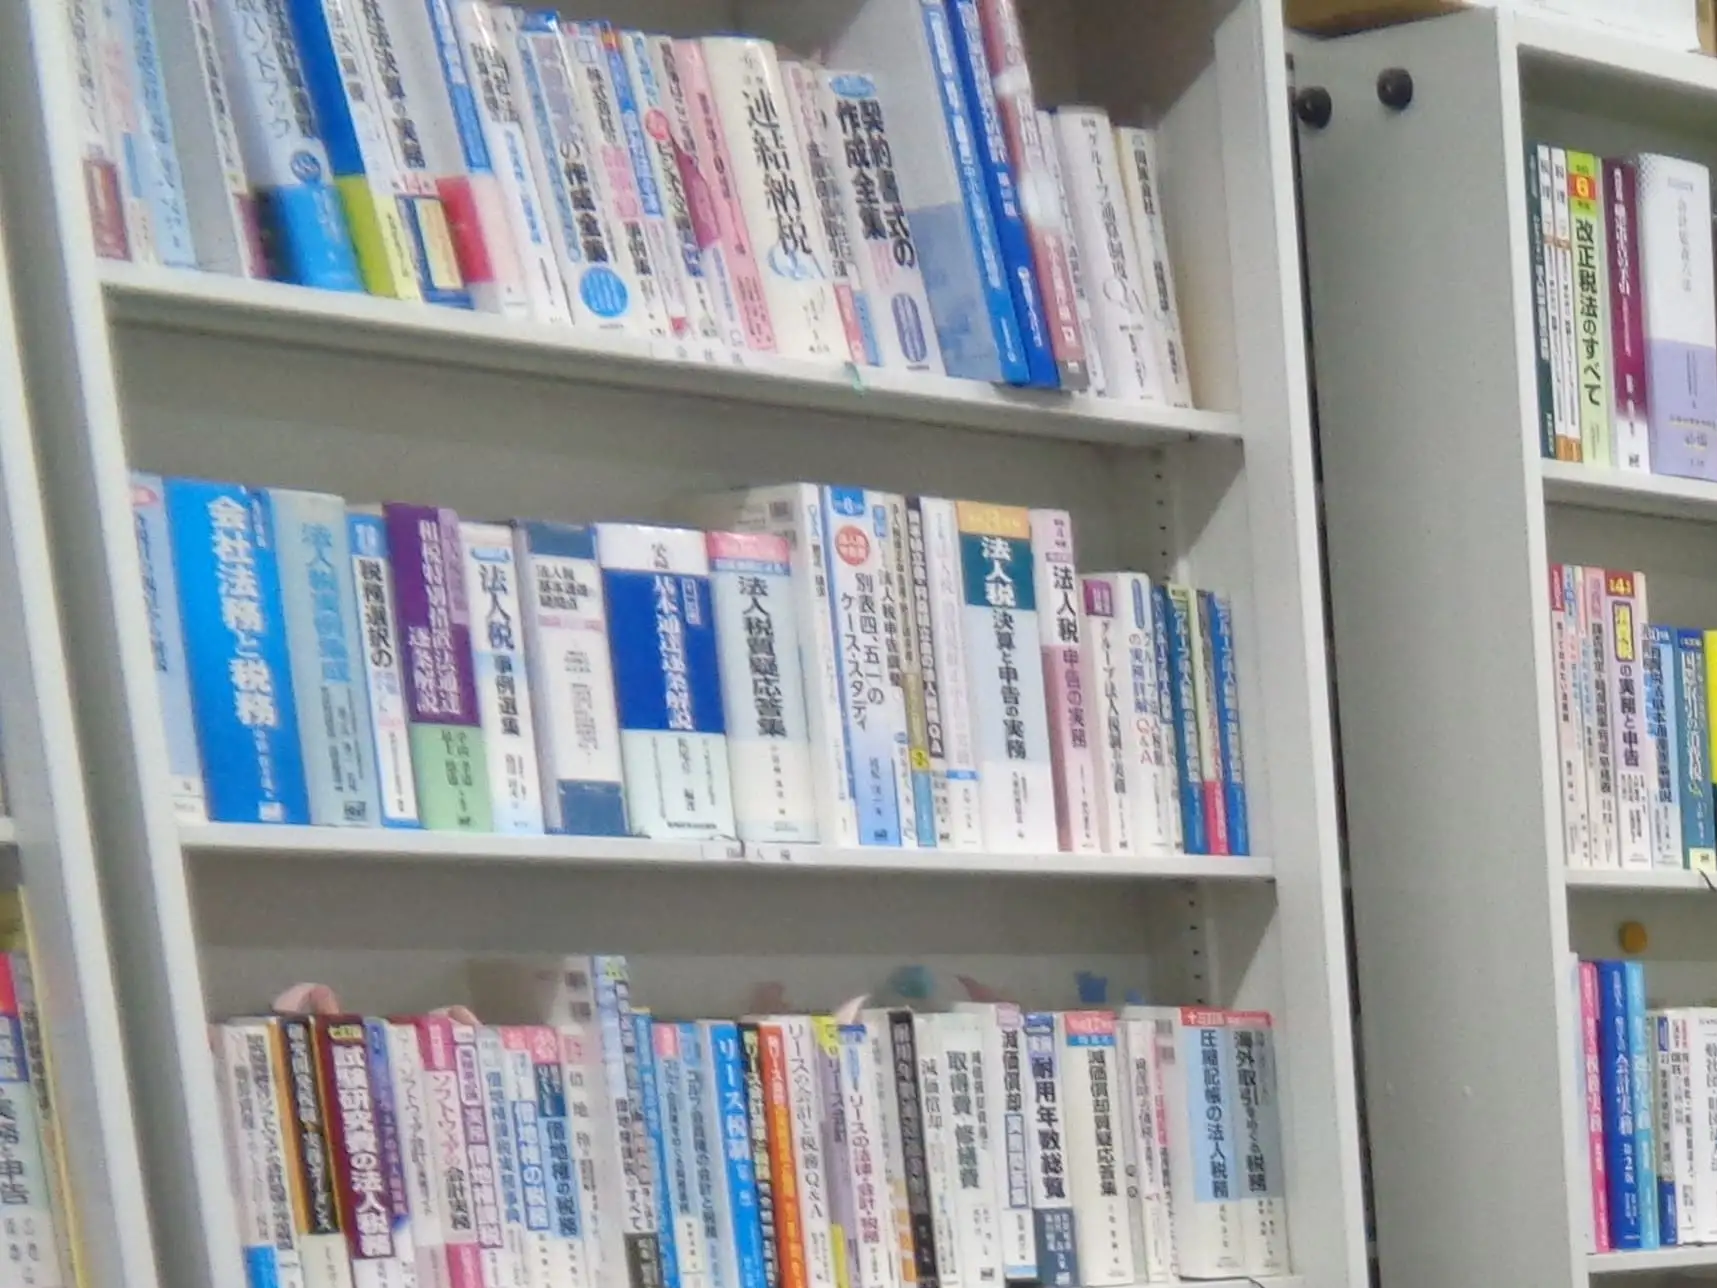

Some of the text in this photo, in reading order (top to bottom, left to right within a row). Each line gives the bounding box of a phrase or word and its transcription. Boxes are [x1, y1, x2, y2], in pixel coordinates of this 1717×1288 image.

[743, 87, 813, 254] 連結納税
[837, 99, 888, 242] 作成全集
[1575, 217, 1601, 407] 改正税法のすべて
[981, 536, 1015, 607] 法人税
[1052, 564, 1079, 644] 法人税
